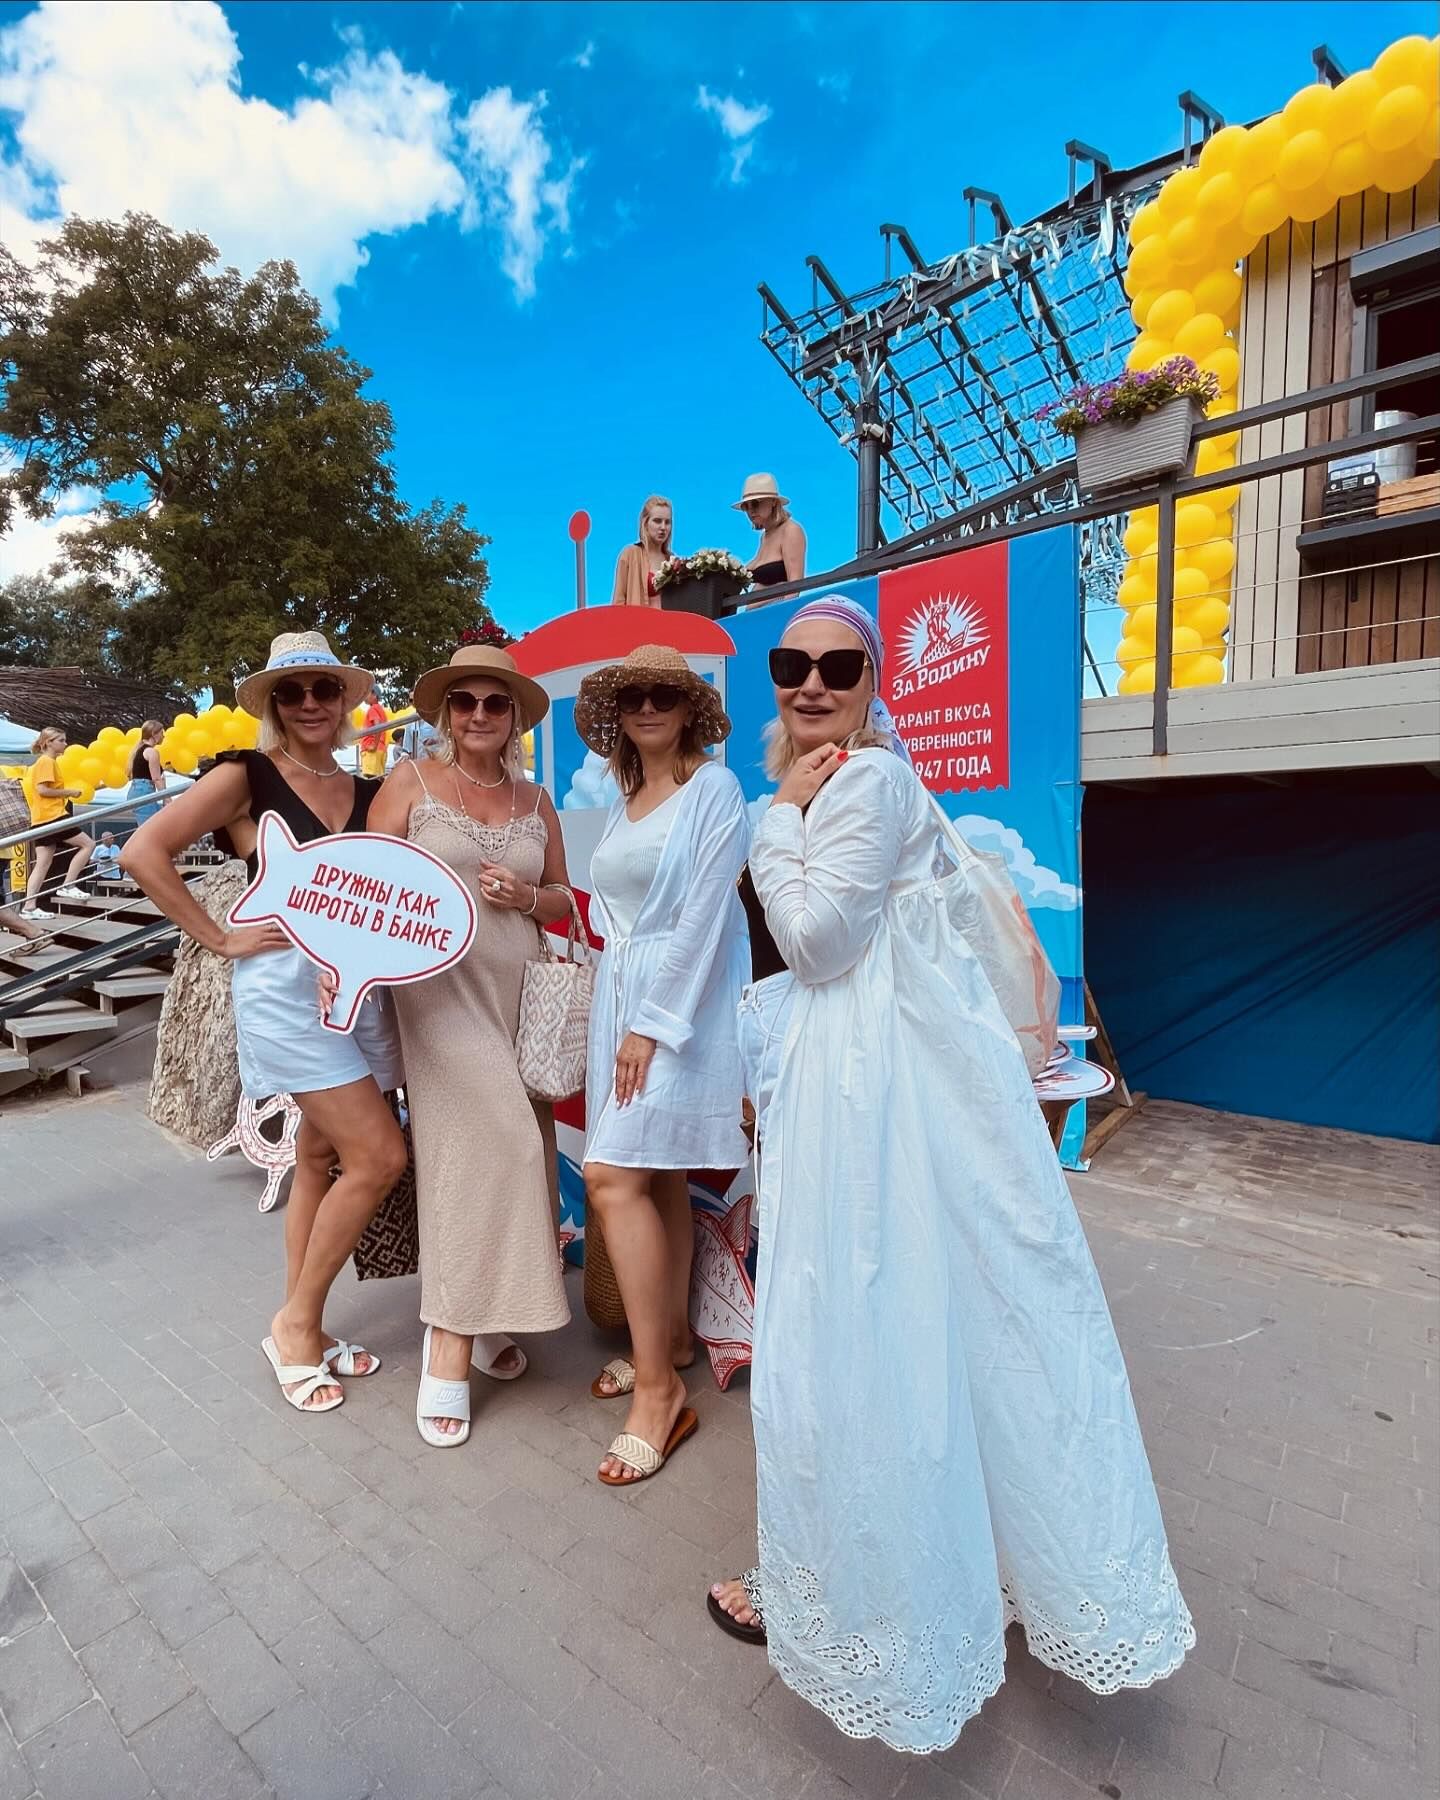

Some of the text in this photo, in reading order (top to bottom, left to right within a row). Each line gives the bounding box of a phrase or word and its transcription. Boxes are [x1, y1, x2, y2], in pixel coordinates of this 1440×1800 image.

[893, 702, 991, 730] ГАРАНТ ВКУСА
[904, 728, 992, 753] УВЕРЕННОСТИ
[915, 754, 992, 780] 947 ГОДА
[311, 863, 441, 919] ДРУЖНЫ КАК
[287, 885, 453, 952] ШПРОТЫ В БАНКЕ
